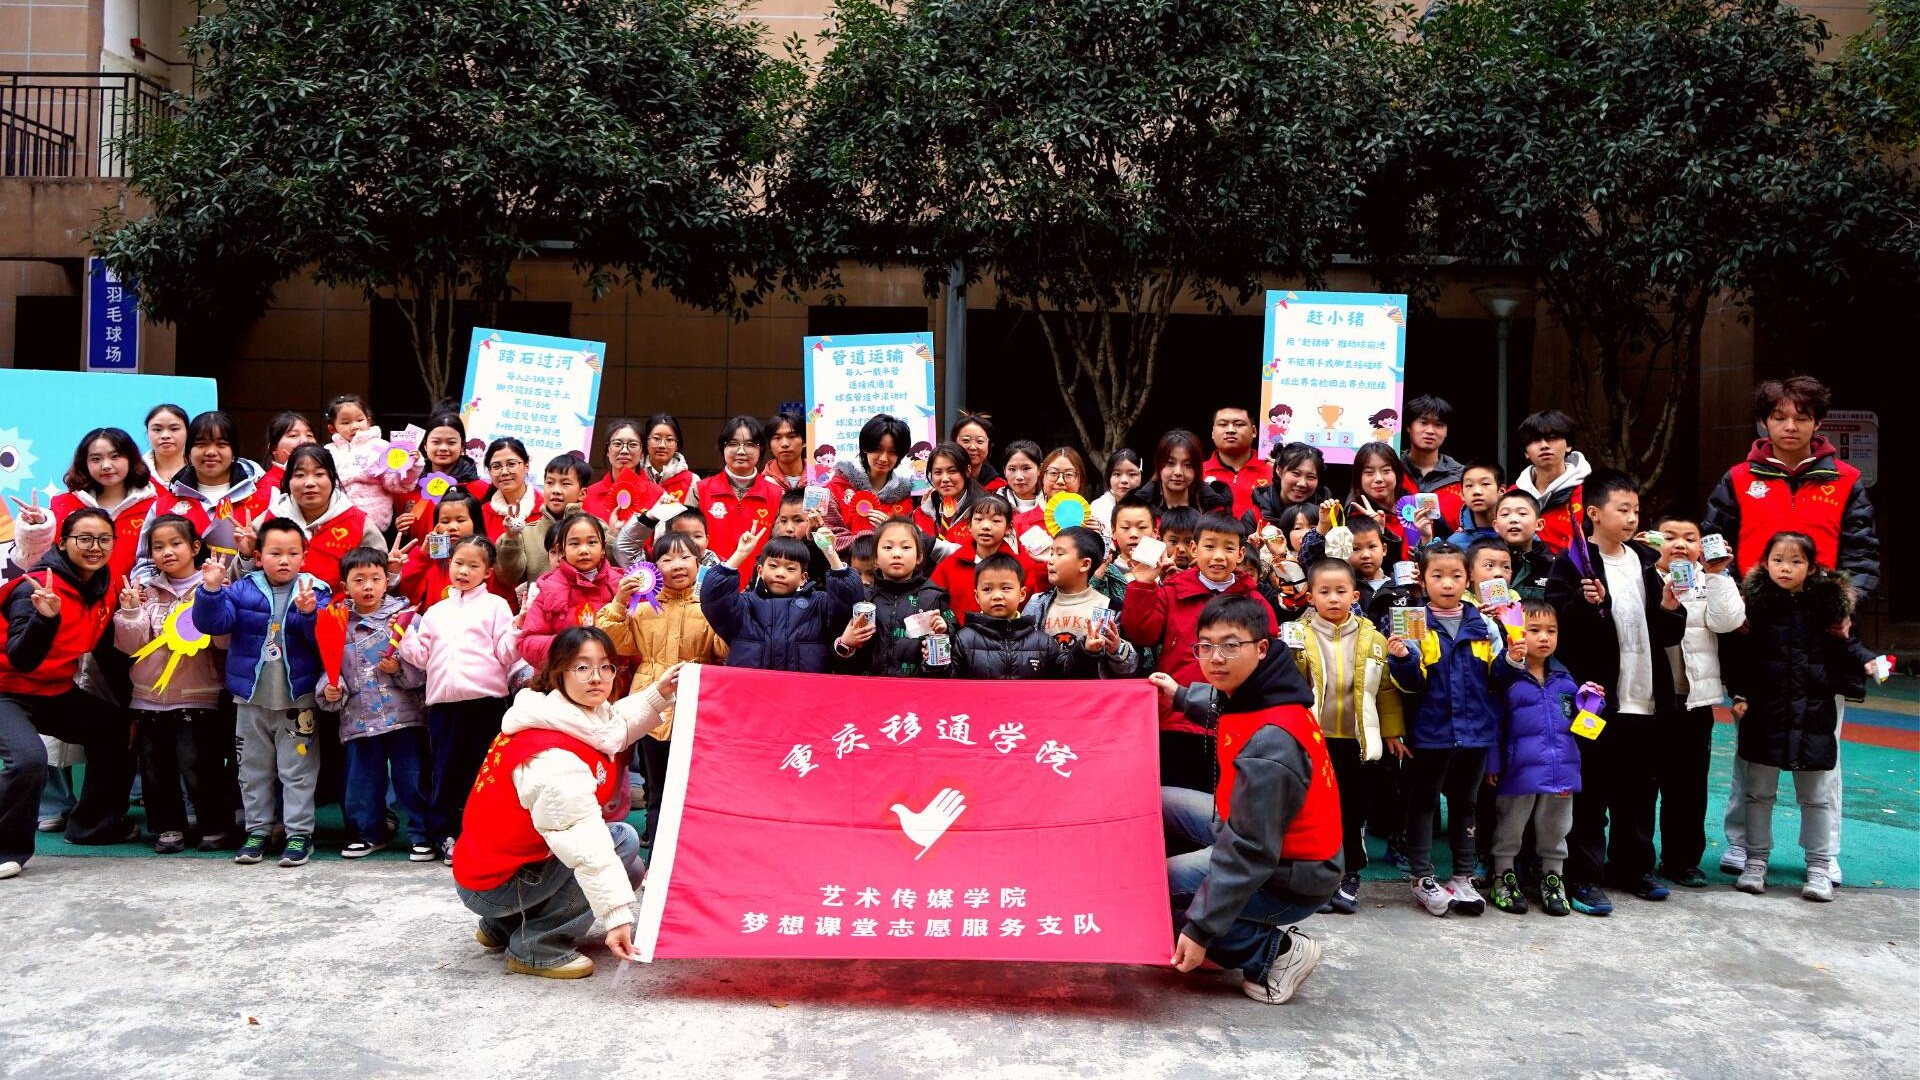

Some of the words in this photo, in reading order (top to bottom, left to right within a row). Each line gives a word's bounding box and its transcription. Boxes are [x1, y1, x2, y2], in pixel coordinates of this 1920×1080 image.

[105, 287, 122, 362] 羽毛球场
[1306, 309, 1365, 327] 赶小猪
[498, 349, 574, 370] 踏石过河
[832, 349, 904, 365] 管道运输
[1309, 434, 1316, 443] 3
[1326, 432, 1331, 441] 1
[1343, 435, 1349, 444] 2
[779, 712, 1079, 779] 重庆移通学院
[819, 884, 1028, 909] 艺术传媒学院
[740, 912, 1102, 938] 梦想课堂志愿服务支队
